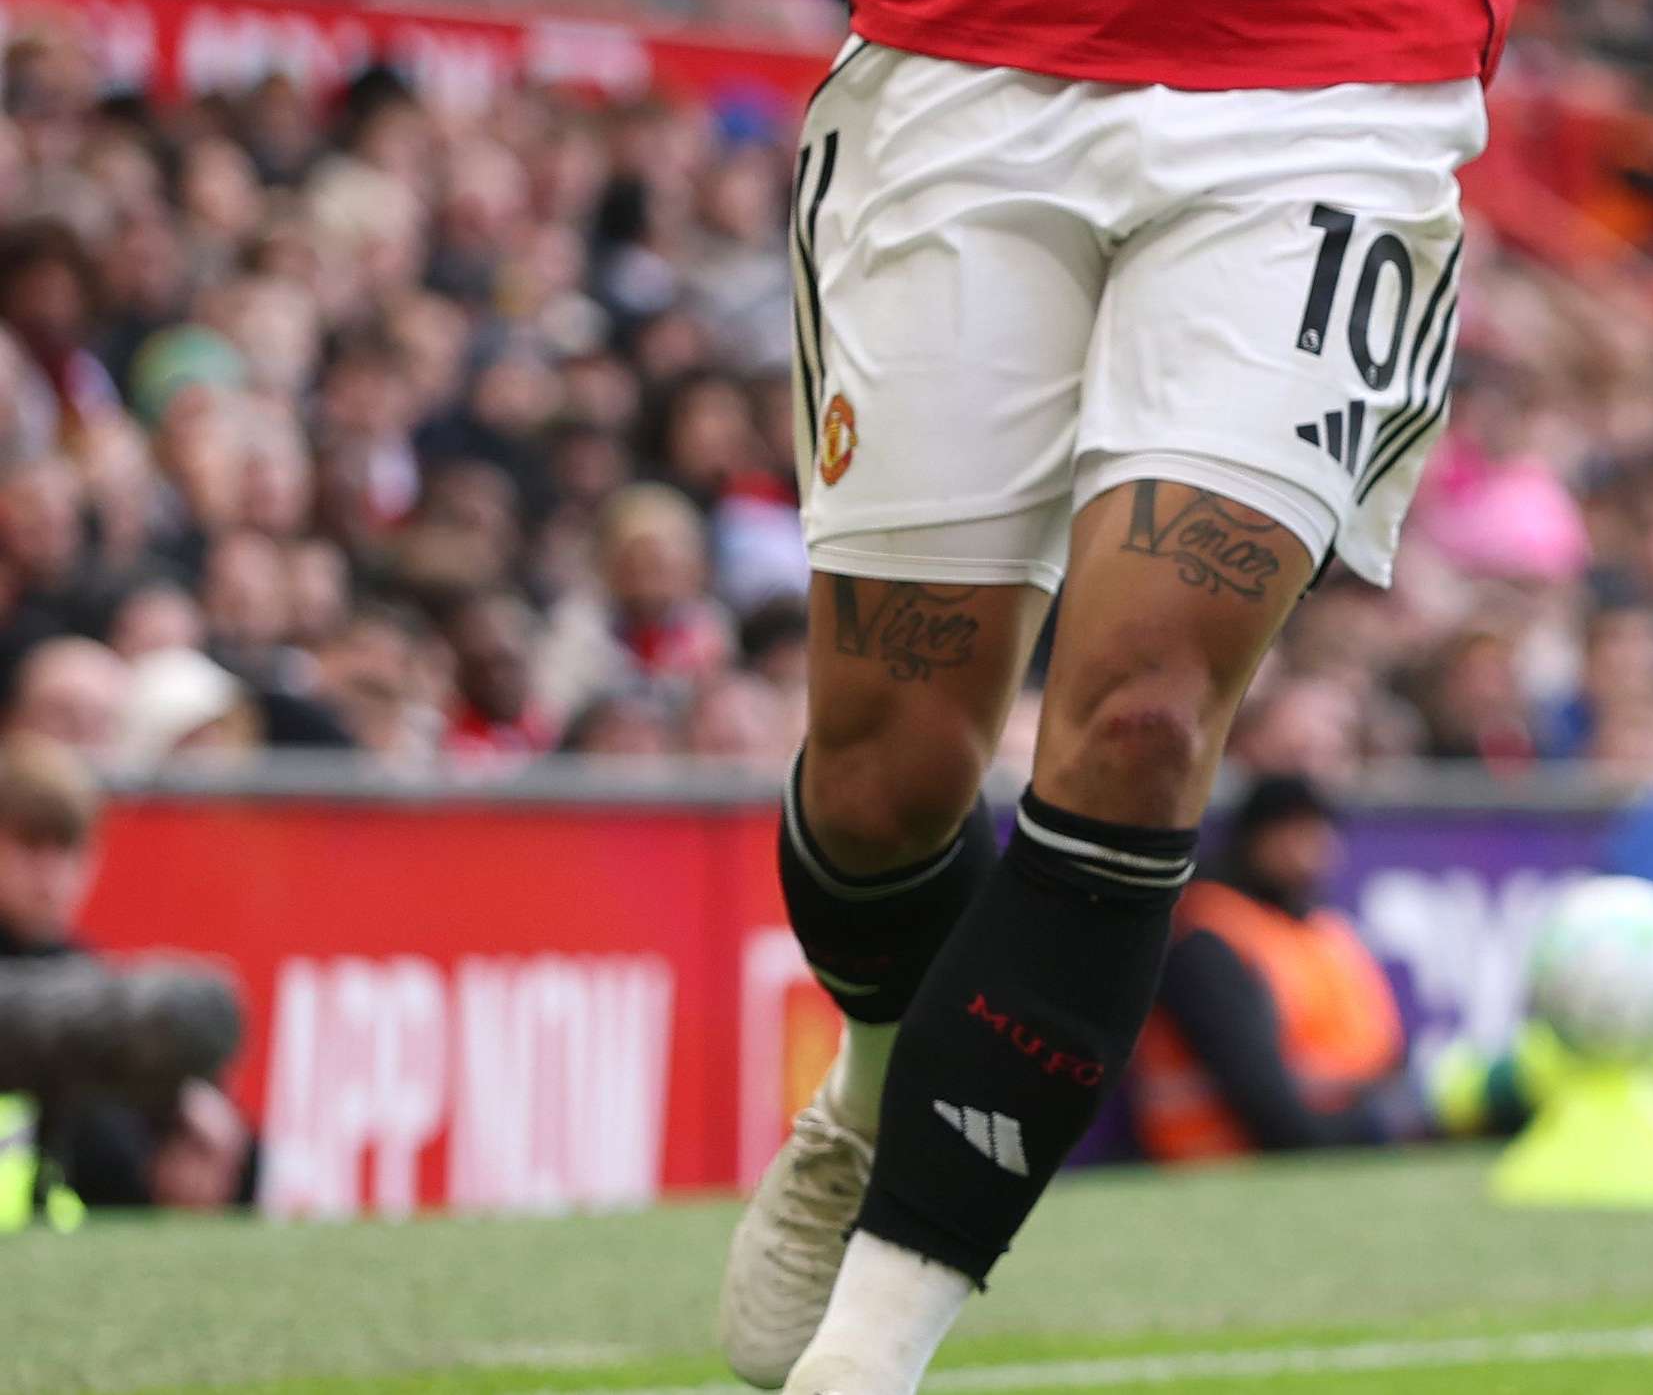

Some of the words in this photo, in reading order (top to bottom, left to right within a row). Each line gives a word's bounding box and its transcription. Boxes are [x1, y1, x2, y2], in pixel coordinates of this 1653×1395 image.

[1296, 203, 1414, 392] 10
[262, 953, 448, 1223] APP
[448, 949, 676, 1218] NOW
